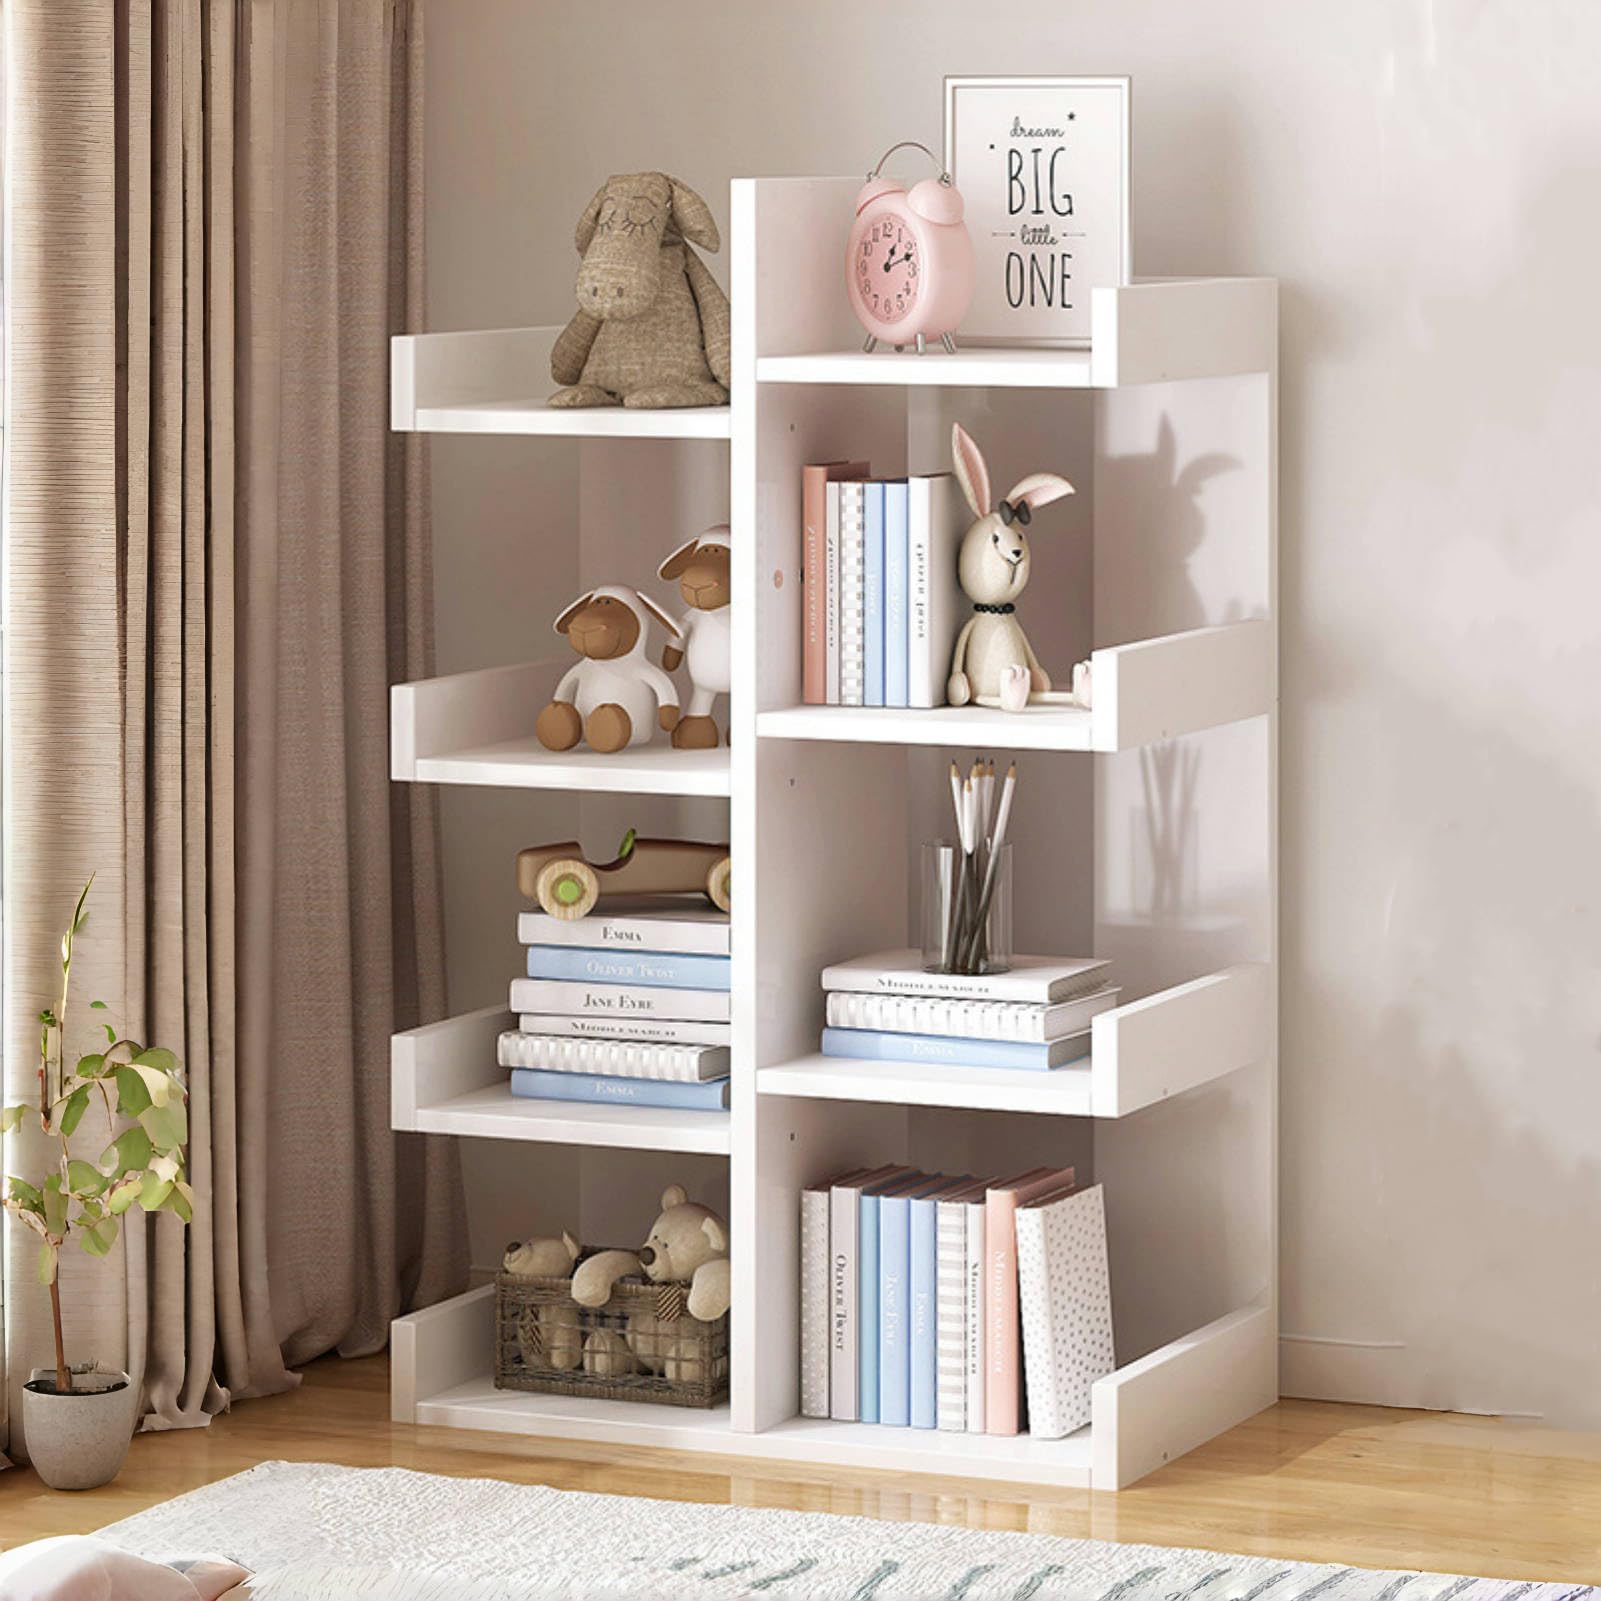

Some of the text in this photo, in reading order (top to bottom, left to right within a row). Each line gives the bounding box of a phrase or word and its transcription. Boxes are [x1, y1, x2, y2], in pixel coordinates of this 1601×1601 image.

[1010, 116, 1065, 137] dream
[1008, 147, 1073, 216] BIG
[882, 222, 893, 237] 12
[898, 228, 902, 243] 1
[1020, 224, 1058, 245] little
[863, 240, 873, 257] 10
[860, 260, 867, 276] 9
[908, 262, 917, 278] 3
[864, 279, 871, 295] 8
[903, 281, 911, 295] 4
[1006, 252, 1073, 309] ONE
[873, 294, 879, 309] 7
[884, 298, 891, 314] 6
[896, 294, 905, 311] 5
[583, 993, 655, 1010] JANE EYRE
